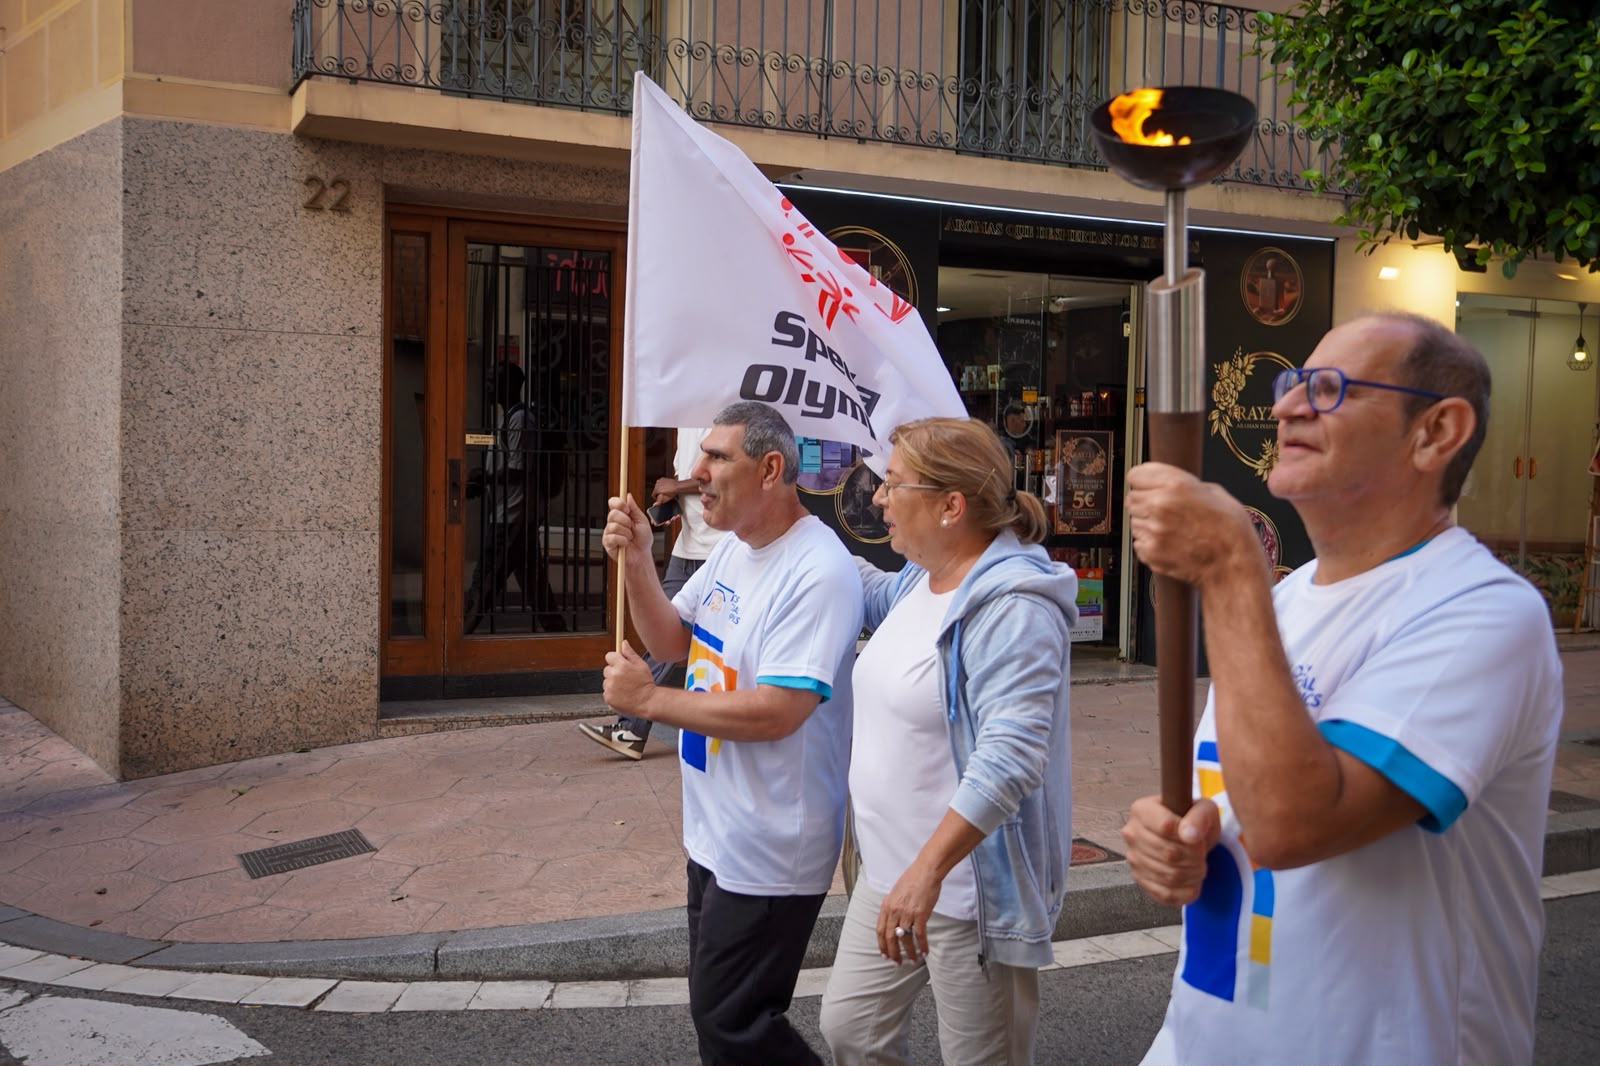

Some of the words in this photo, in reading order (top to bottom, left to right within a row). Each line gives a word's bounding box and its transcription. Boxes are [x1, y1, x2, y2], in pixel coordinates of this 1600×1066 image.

[303, 175, 351, 211] 22
[944, 217, 1004, 236] AROMAS
[1006, 224, 1035, 240] QUE
[1072, 490, 1095, 509] 5€
